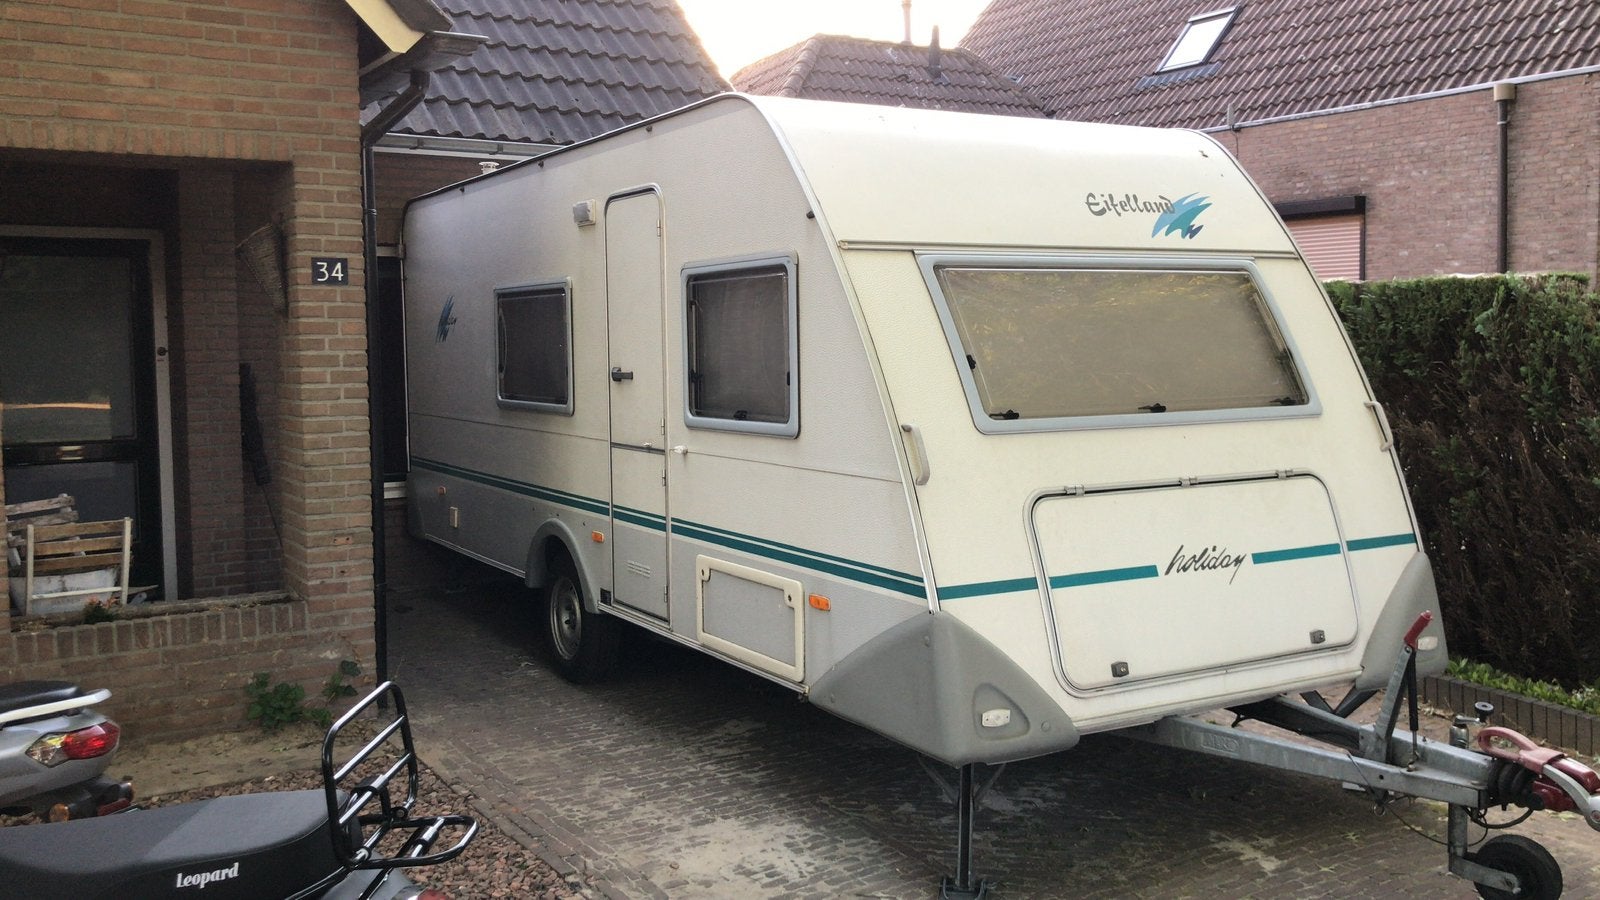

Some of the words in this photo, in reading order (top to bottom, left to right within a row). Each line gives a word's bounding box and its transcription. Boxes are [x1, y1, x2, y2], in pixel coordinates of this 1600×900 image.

[1085, 192, 1175, 217] Eifelland
[316, 261, 344, 281] 34
[1164, 544, 1247, 585] holiday
[176, 862, 240, 889] Leopard
